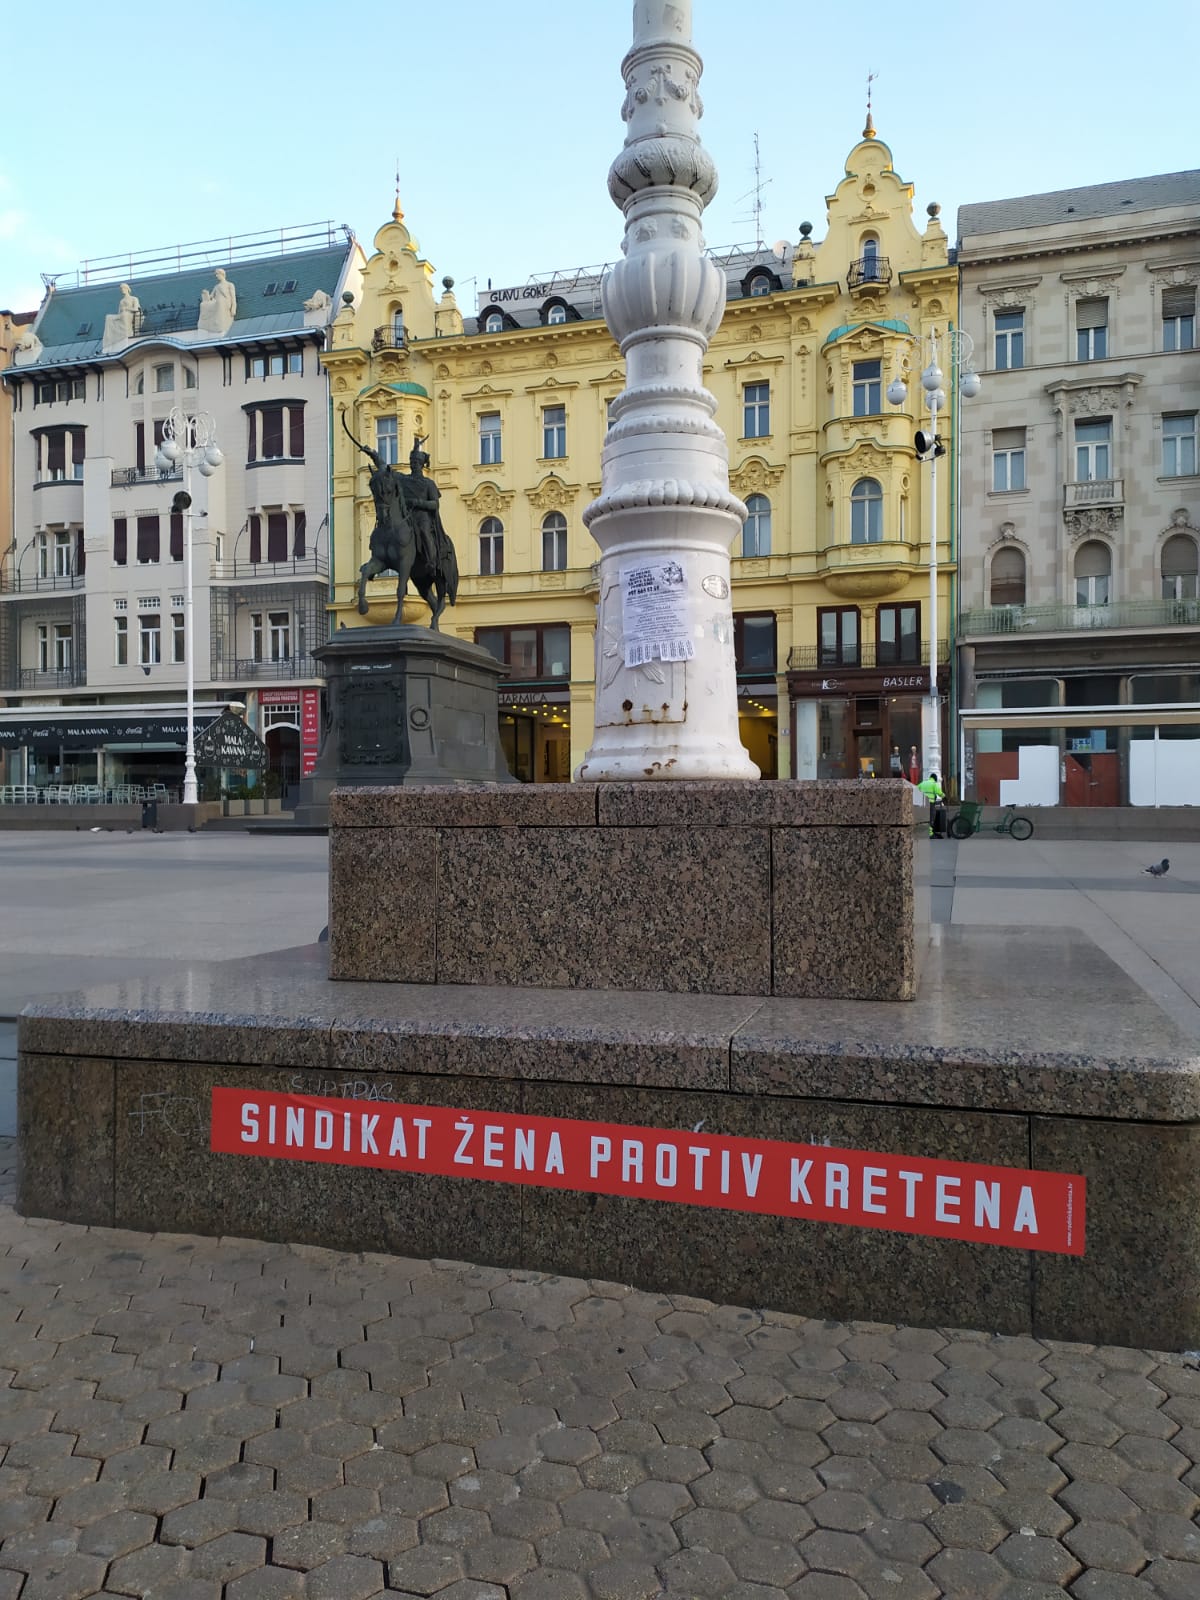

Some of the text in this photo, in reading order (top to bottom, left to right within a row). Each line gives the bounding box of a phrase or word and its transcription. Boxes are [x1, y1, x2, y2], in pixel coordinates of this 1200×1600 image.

[490, 288, 519, 303] GLAVU
[883, 676, 923, 687] BASLER
[67, 728, 85, 736] MALA
[224, 735, 243, 745] MALA
[221, 745, 246, 756] KAVANA
[240, 1102, 1039, 1234] SINDIKAT ŽENA PROTIV KRETENA
